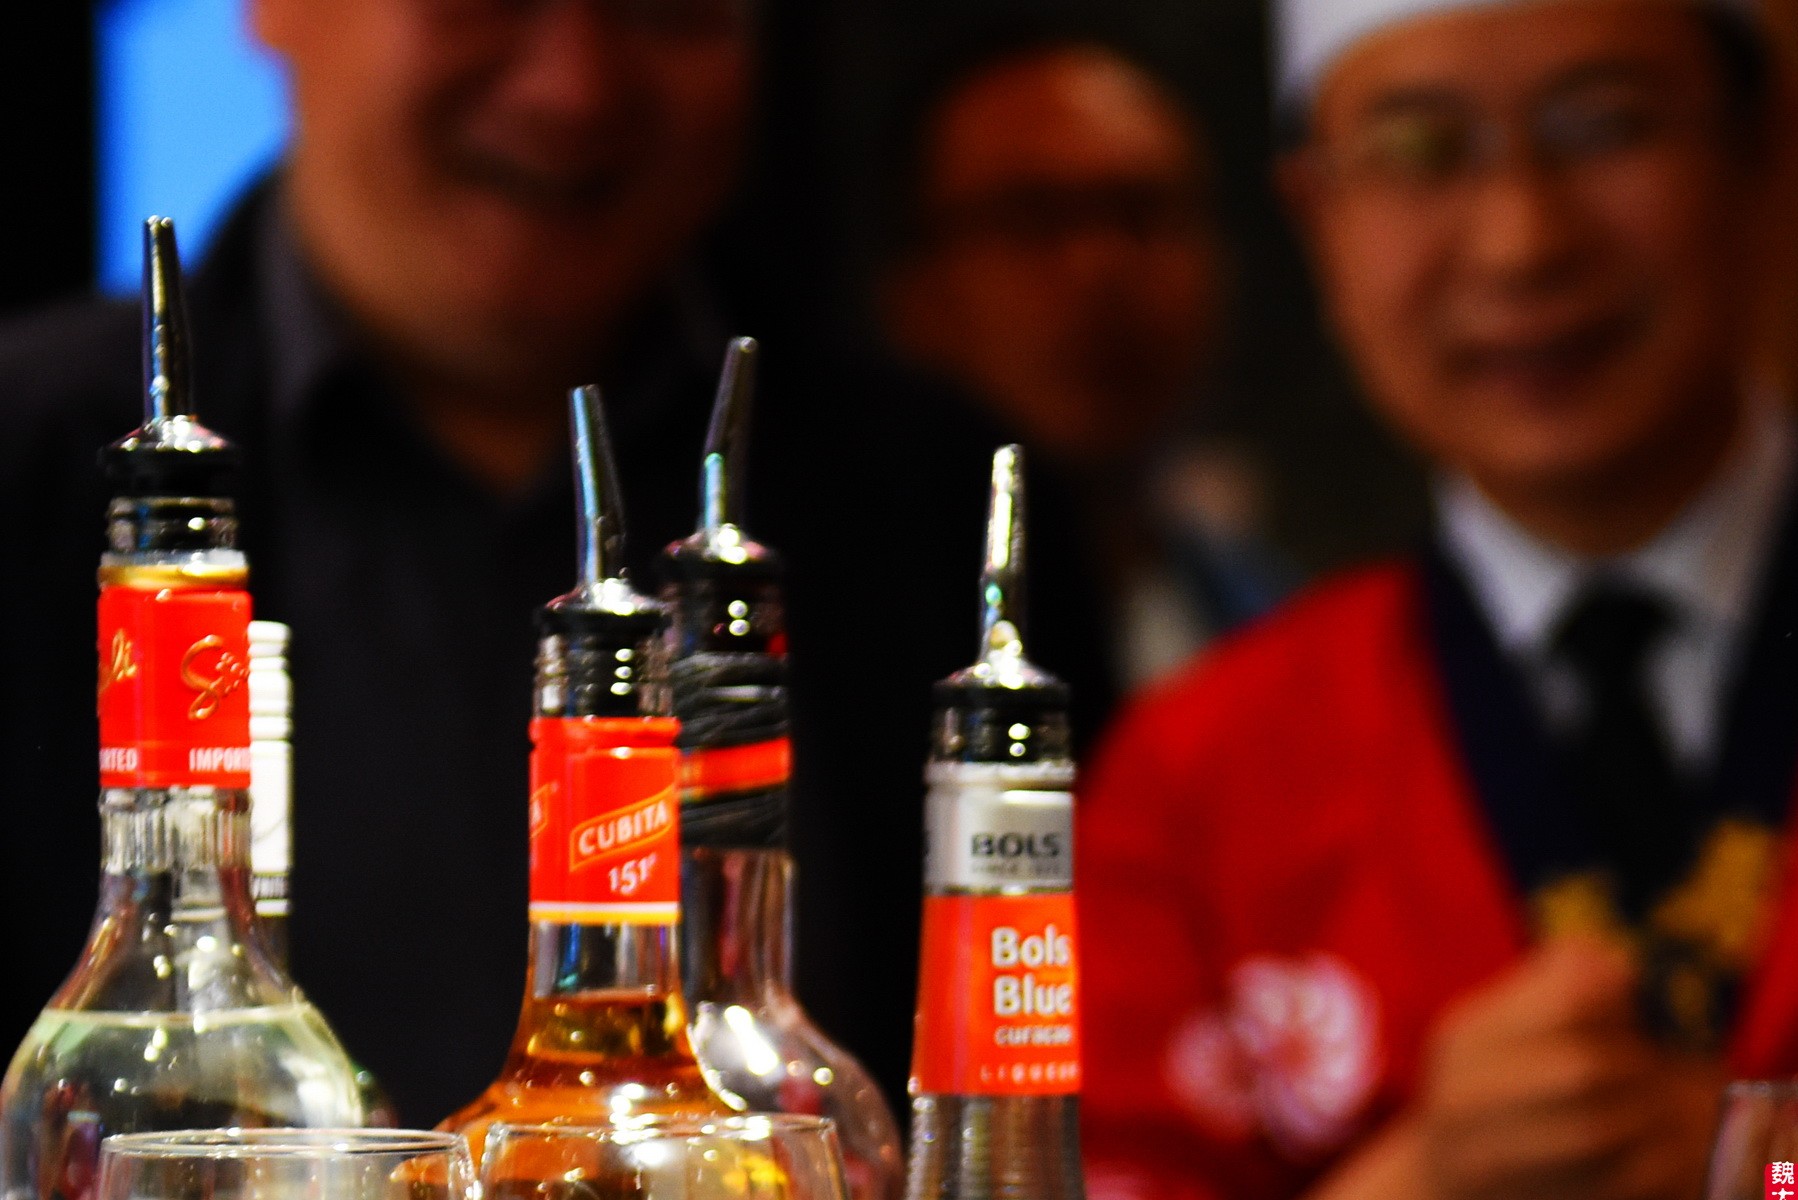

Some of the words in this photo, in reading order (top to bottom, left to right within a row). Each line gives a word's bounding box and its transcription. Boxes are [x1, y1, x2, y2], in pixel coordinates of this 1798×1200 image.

[578, 800, 668, 856] CUBITA
[971, 832, 1061, 858] BOLS
[991, 924, 1070, 968] Bols
[994, 973, 1072, 1016] Blue
